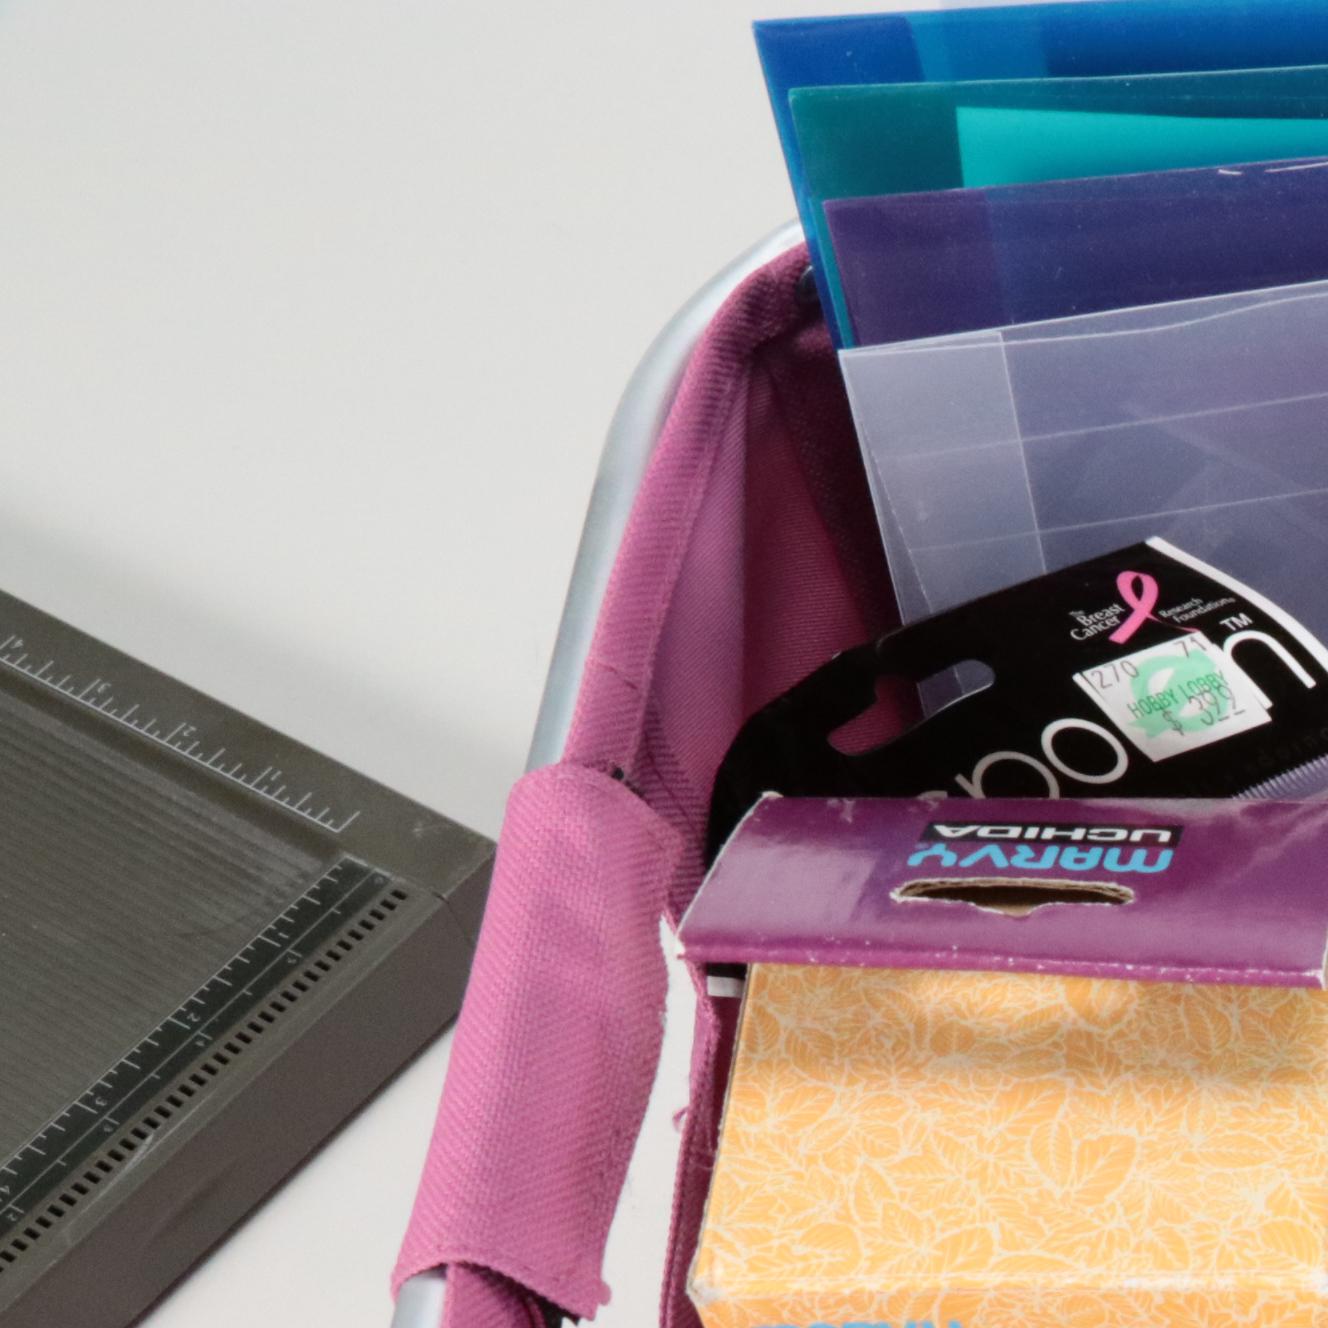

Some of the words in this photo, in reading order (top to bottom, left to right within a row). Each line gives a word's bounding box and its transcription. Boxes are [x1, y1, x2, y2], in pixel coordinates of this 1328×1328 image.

[1076, 602, 1126, 627] Breast
[1070, 615, 1122, 641] Cancer
[1127, 689, 1178, 720] HOBBY
[1179, 670, 1230, 705] LOBBY
[933, 823, 1173, 843] UCHIDA
[907, 842, 1175, 874] MARVY
